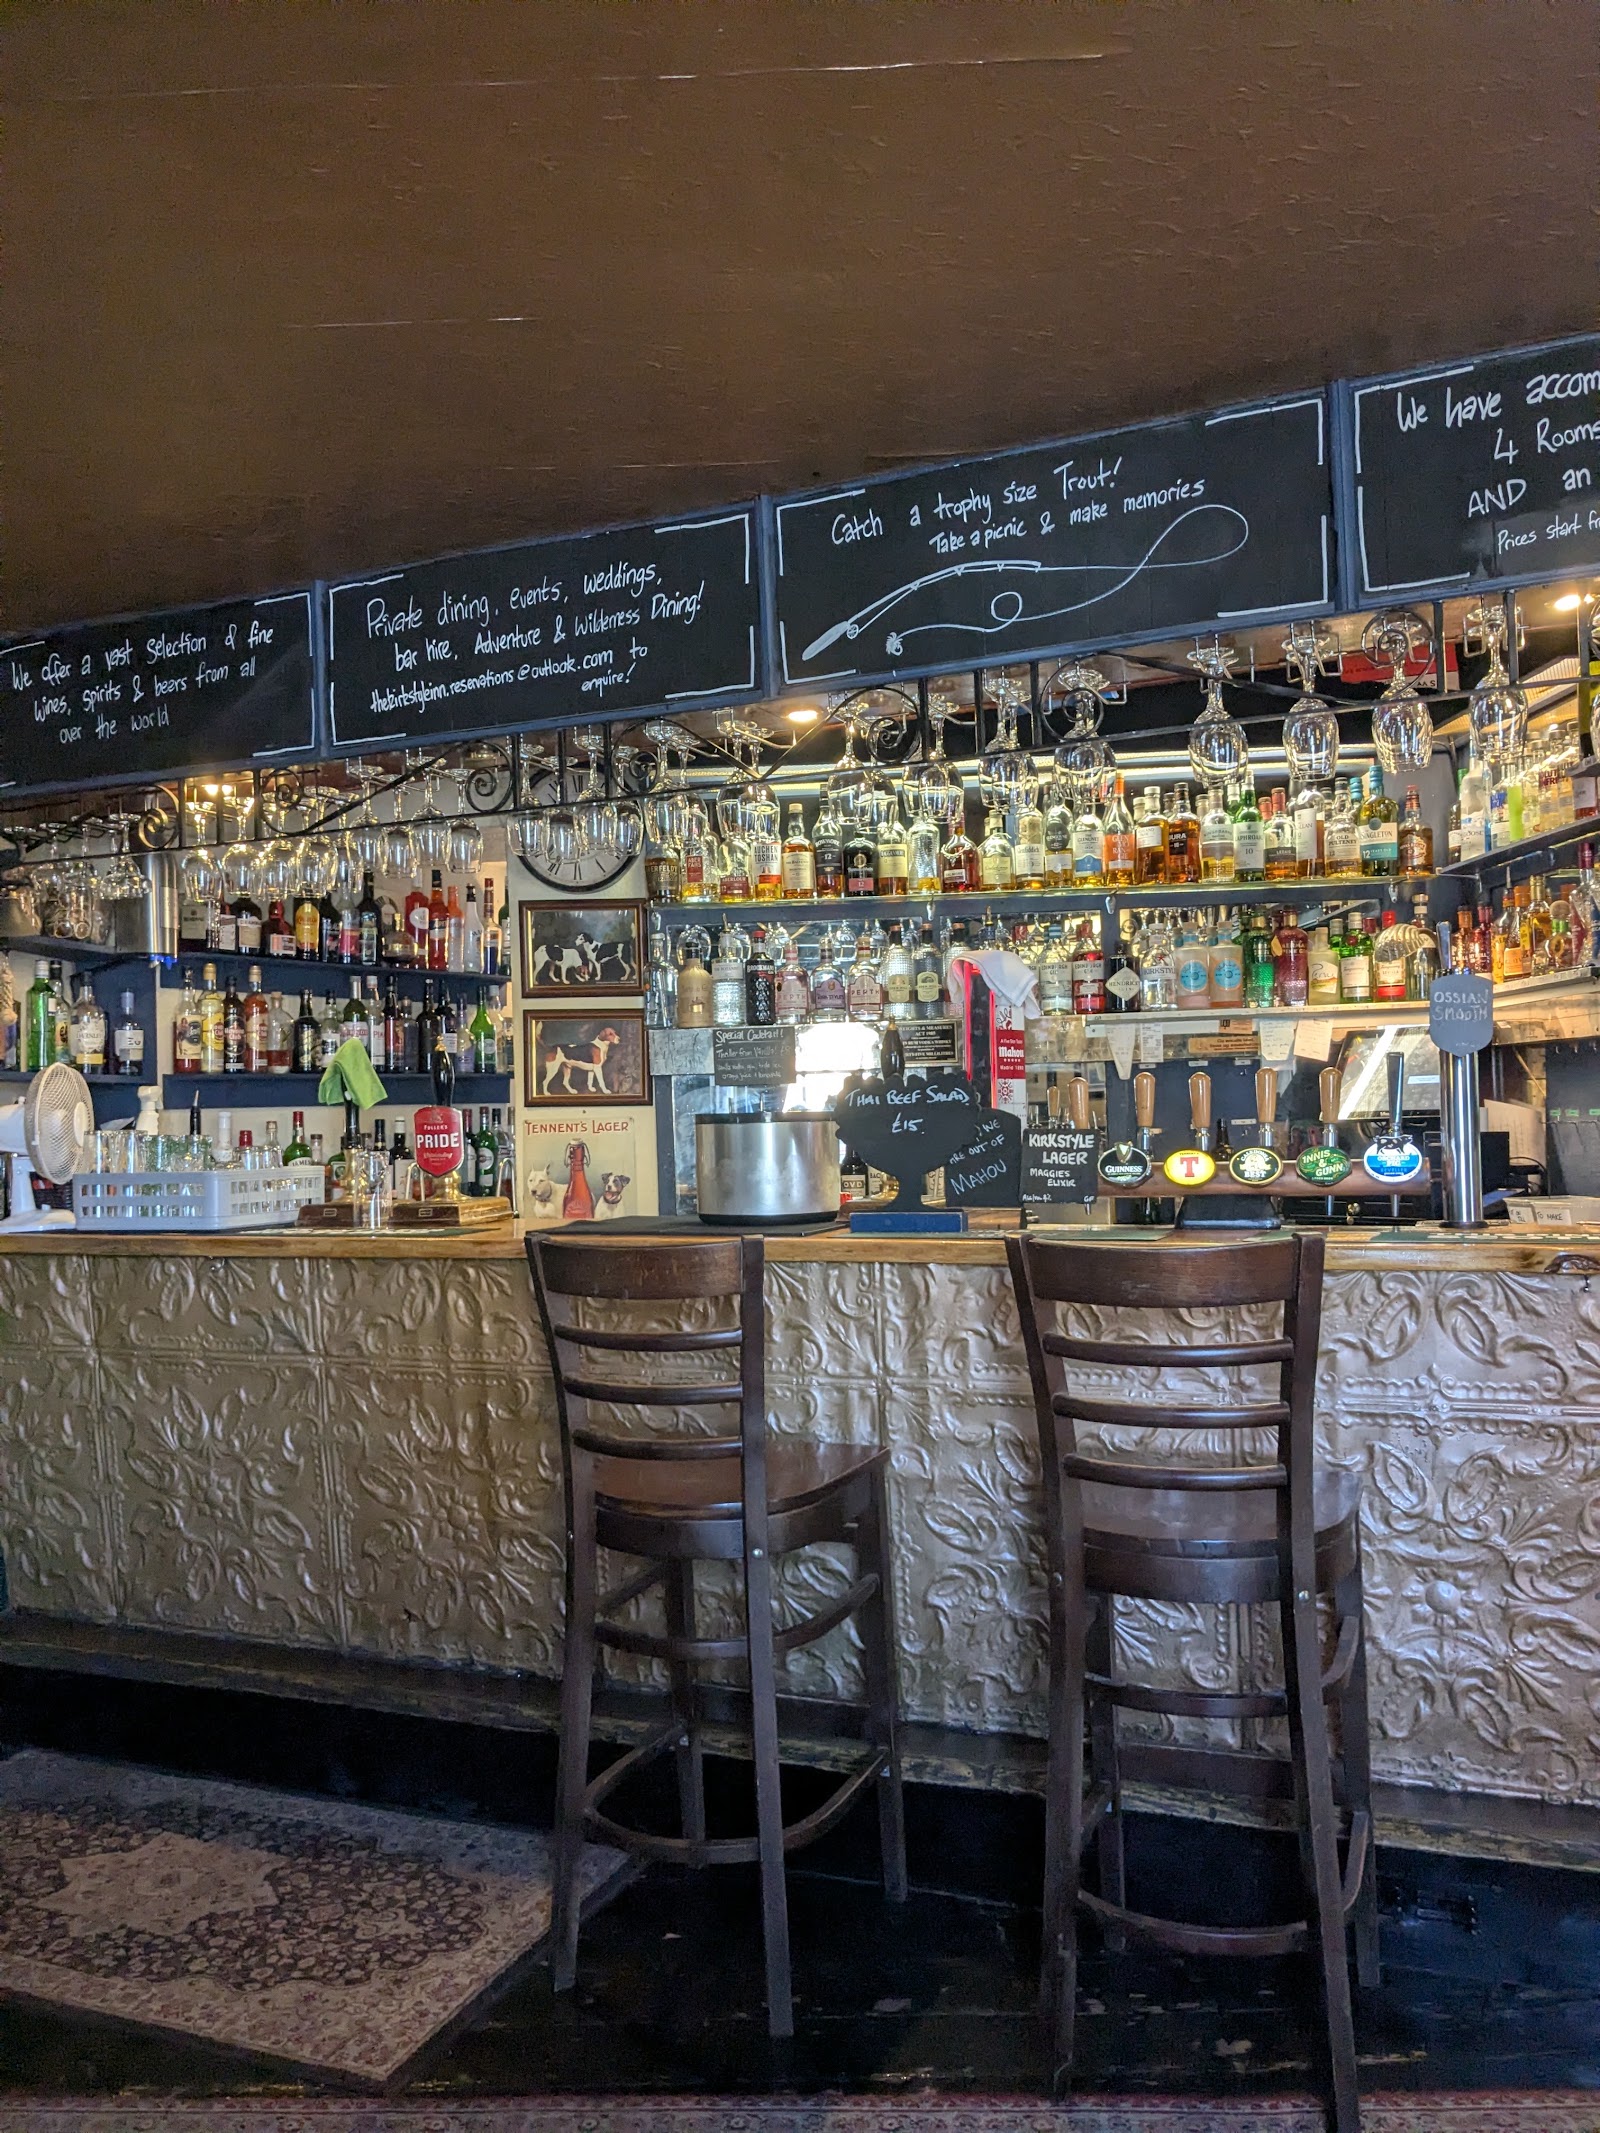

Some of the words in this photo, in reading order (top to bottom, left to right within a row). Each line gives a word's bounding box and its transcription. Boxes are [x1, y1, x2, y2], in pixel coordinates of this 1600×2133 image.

[1397, 391, 1429, 432] We
[1446, 387, 1502, 428] have
[1494, 428, 1519, 465] 4
[831, 507, 883, 546] Catch
[910, 503, 921, 527] a
[933, 488, 993, 523] trophy
[1002, 481, 1037, 504] size
[1053, 456, 1122, 494] Trout!
[1468, 478, 1527, 518] AND
[1562, 467, 1591, 491] an
[929, 528, 966, 555] Take
[970, 529, 981, 547] a
[984, 520, 1027, 545] picnic
[1040, 513, 1055, 535] &
[1069, 502, 1108, 526] make
[1123, 478, 1205, 514] memories
[1497, 529, 1537, 555] Prices
[1546, 512, 1582, 540] start
[367, 597, 423, 638] Private
[395, 643, 418, 672] bar
[474, 624, 541, 656] Adventure
[553, 615, 566, 644] &
[650, 580, 705, 625] Dining!
[12, 662, 32, 691] We
[41, 653, 72, 686] offer
[81, 655, 91, 675] a
[105, 640, 133, 671] vast
[247, 620, 274, 649] fine
[629, 636, 648, 659] to
[154, 675, 187, 697] beers
[196, 661, 229, 689] from
[240, 656, 256, 677] all
[581, 662, 637, 698] enquire!
[60, 726, 82, 744] over
[95, 713, 118, 740] the
[131, 704, 169, 731] world
[1433, 989, 1489, 1004] OSSIAN
[998, 1046, 1025, 1058] Mahou
[886, 1089, 921, 1105] BEEF
[525, 1120, 588, 1136] TENNENT'S
[592, 1119, 629, 1134] LAGER
[982, 1119, 1001, 1132] WE
[417, 1132, 460, 1148] PRIDE
[968, 1141, 988, 1155] OUT
[991, 1134, 1005, 1147] OF
[1028, 1133, 1095, 1150] KIRKSTYLE
[1042, 1151, 1088, 1165] LAGER
[1105, 1165, 1143, 1173] GUINNESS
[1180, 1157, 1199, 1177] T
[950, 1159, 1007, 1195] MAHOU
[1029, 1168, 1071, 1178] MAGGIES
[1315, 1163, 1343, 1177] GUNN
[1047, 1179, 1076, 1187] ELIXIR
